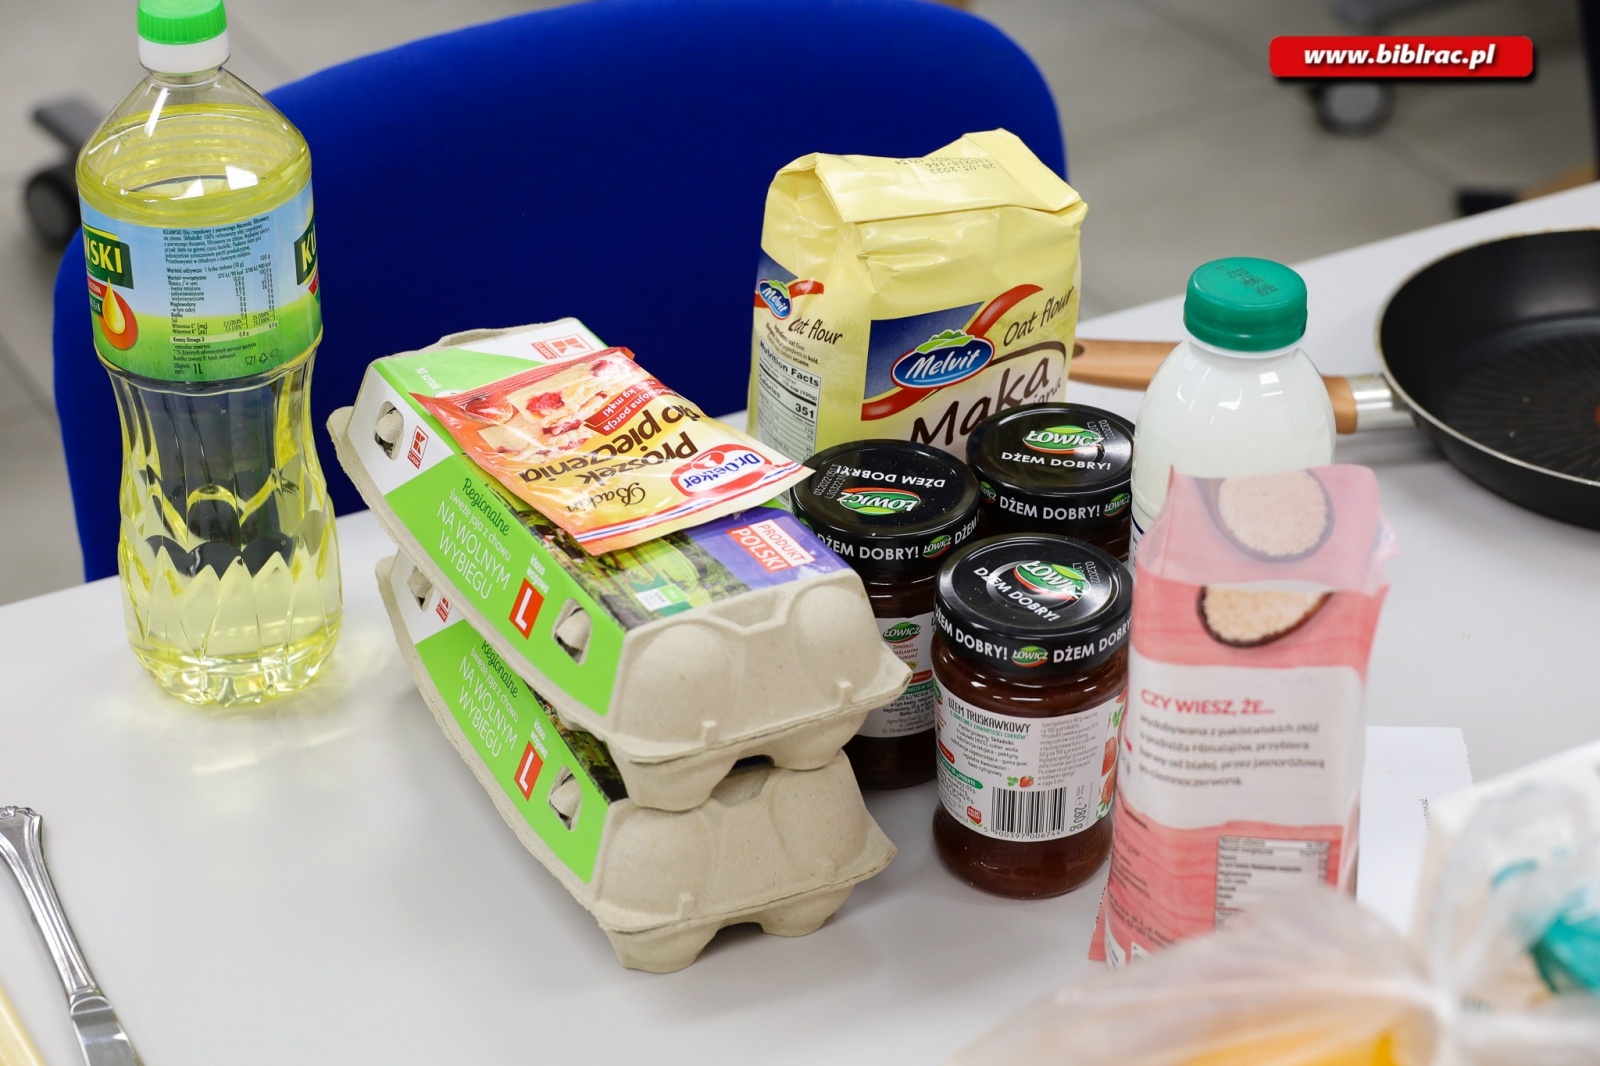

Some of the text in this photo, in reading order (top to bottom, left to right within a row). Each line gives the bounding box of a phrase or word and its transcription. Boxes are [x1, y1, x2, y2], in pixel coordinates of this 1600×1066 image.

[762, 287, 788, 313] Melvit
[1003, 286, 1075, 347] Oat flour
[807, 319, 843, 345] flour
[790, 368, 819, 387] Facts
[905, 349, 981, 380] Melvit
[602, 388, 637, 417] kg mąki
[795, 402, 814, 419] 351
[603, 406, 632, 433] porcja
[519, 409, 663, 483] pieczenia
[1025, 430, 1104, 446] ŁOWICZ
[574, 430, 699, 486] Proszek
[1000, 451, 1112, 471] DŻEM DOBRY!
[836, 465, 897, 483] DOBRY!
[901, 475, 946, 488] DŻEM
[463, 477, 510, 536] Regionalne
[836, 491, 920, 512] ŁOWICZ
[1000, 493, 1131, 521] DŻEM DOBRY! ŁOWICZ
[437, 500, 511, 591] NA WOLNYM
[489, 533, 512, 561] chowu
[731, 527, 789, 571] POLSKI
[759, 523, 806, 562] PRODUKT
[817, 517, 977, 561] DŻEM DOBRY! ŁOWICZ DŻEM
[439, 530, 493, 600] WYBIEGU
[1020, 560, 1092, 599] ŁOWICZ
[515, 586, 533, 631] L
[973, 566, 1061, 622] DŻEM DOBRY!
[884, 625, 921, 637] ŁOWICZ
[955, 627, 1008, 661] DOBRY!
[1012, 648, 1049, 661] ŁOWICZ
[1052, 644, 1095, 664] DŻEM
[481, 640, 518, 698] Regionalne
[459, 655, 518, 751] NA WOLNYM
[501, 693, 519, 723] chowu
[1140, 688, 1275, 717] CZY WIESZ, ŻE...
[459, 686, 502, 758] WYBIEGU
[965, 708, 1031, 734] TRUSKAWKOWY
[1255, 739, 1310, 753] przybiera
[519, 750, 535, 792] L
[1168, 759, 1183, 767] od
[1221, 759, 1251, 770] przez
[1073, 803, 1087, 824] 280
[983, 826, 989, 834] 5
